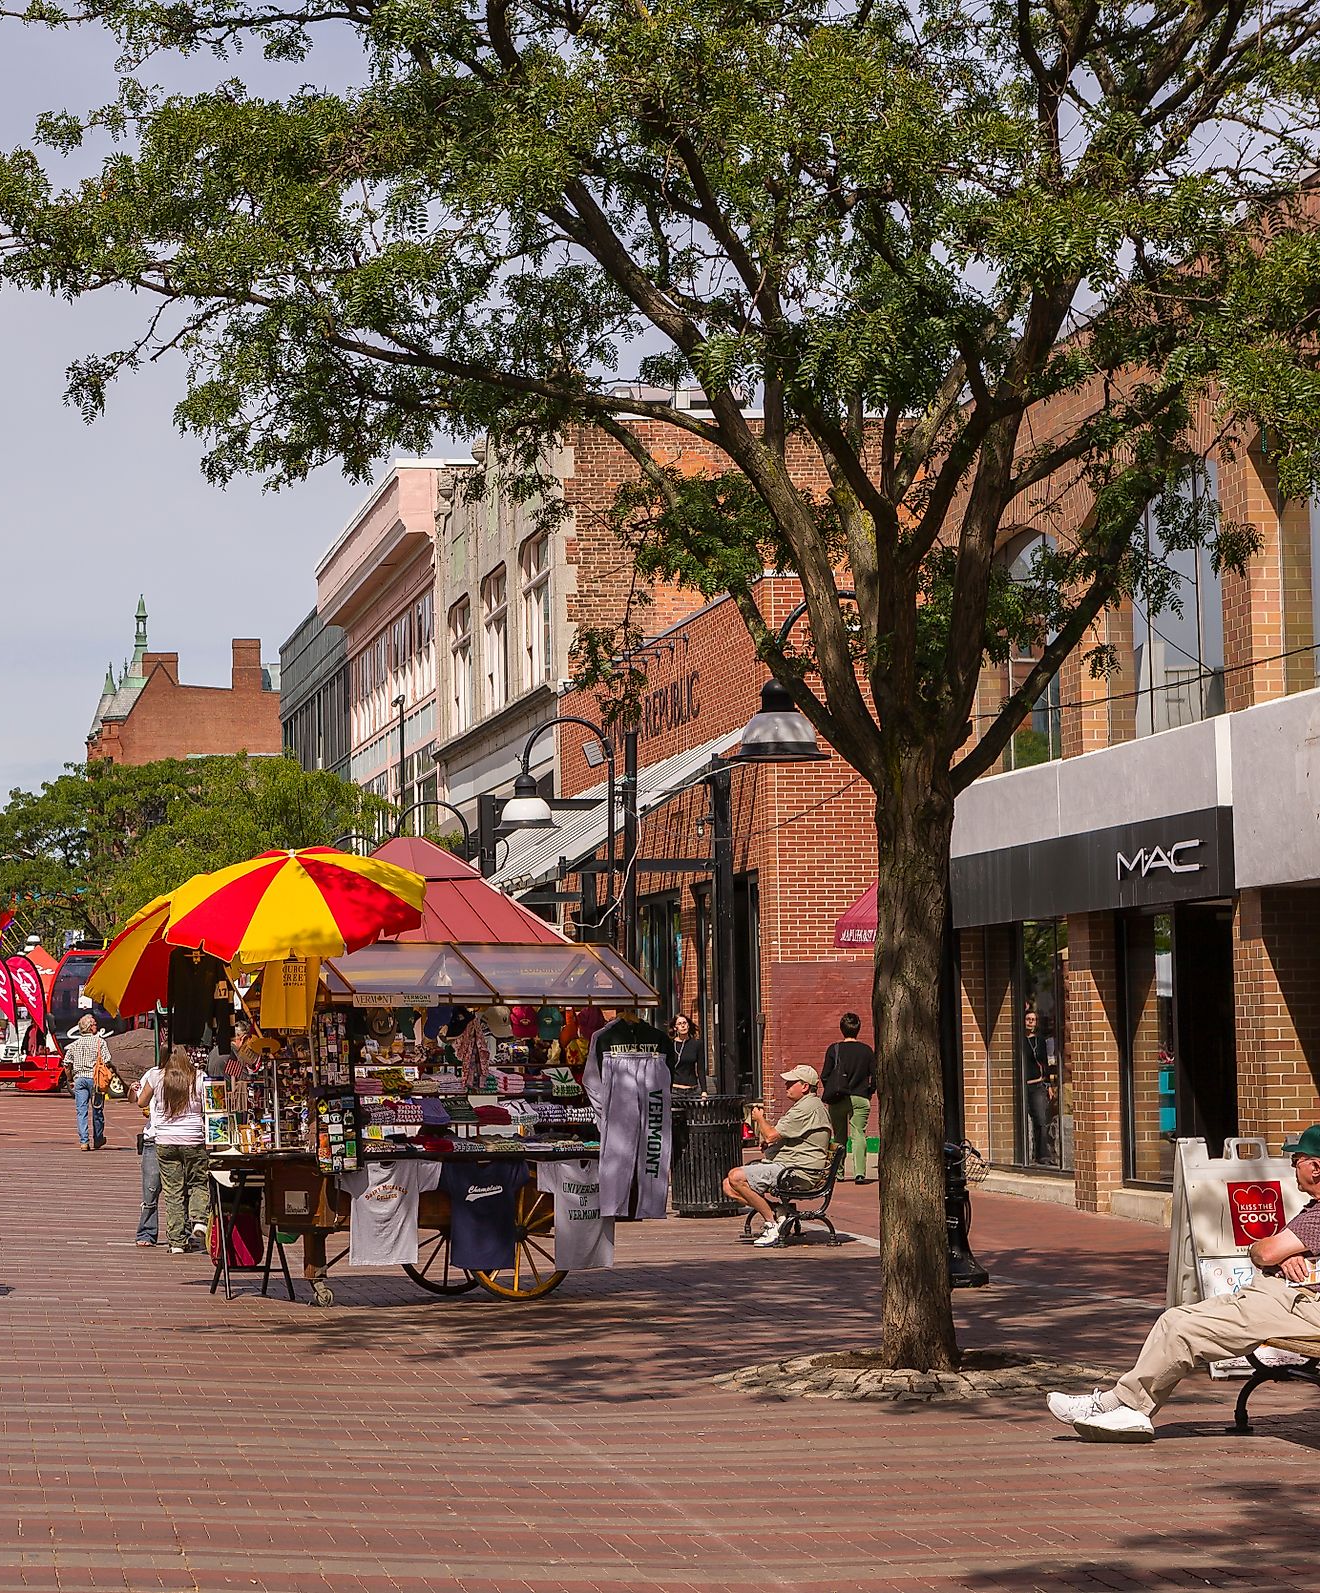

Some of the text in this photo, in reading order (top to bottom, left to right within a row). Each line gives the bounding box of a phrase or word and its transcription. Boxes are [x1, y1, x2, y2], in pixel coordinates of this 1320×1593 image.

[645, 671, 700, 740] REPUBLIC
[645, 1089, 663, 1179] VERMONT
[579, 1196, 588, 1206] OF
[1240, 1203, 1257, 1211] KISS
[1239, 1212, 1278, 1223] COOK
